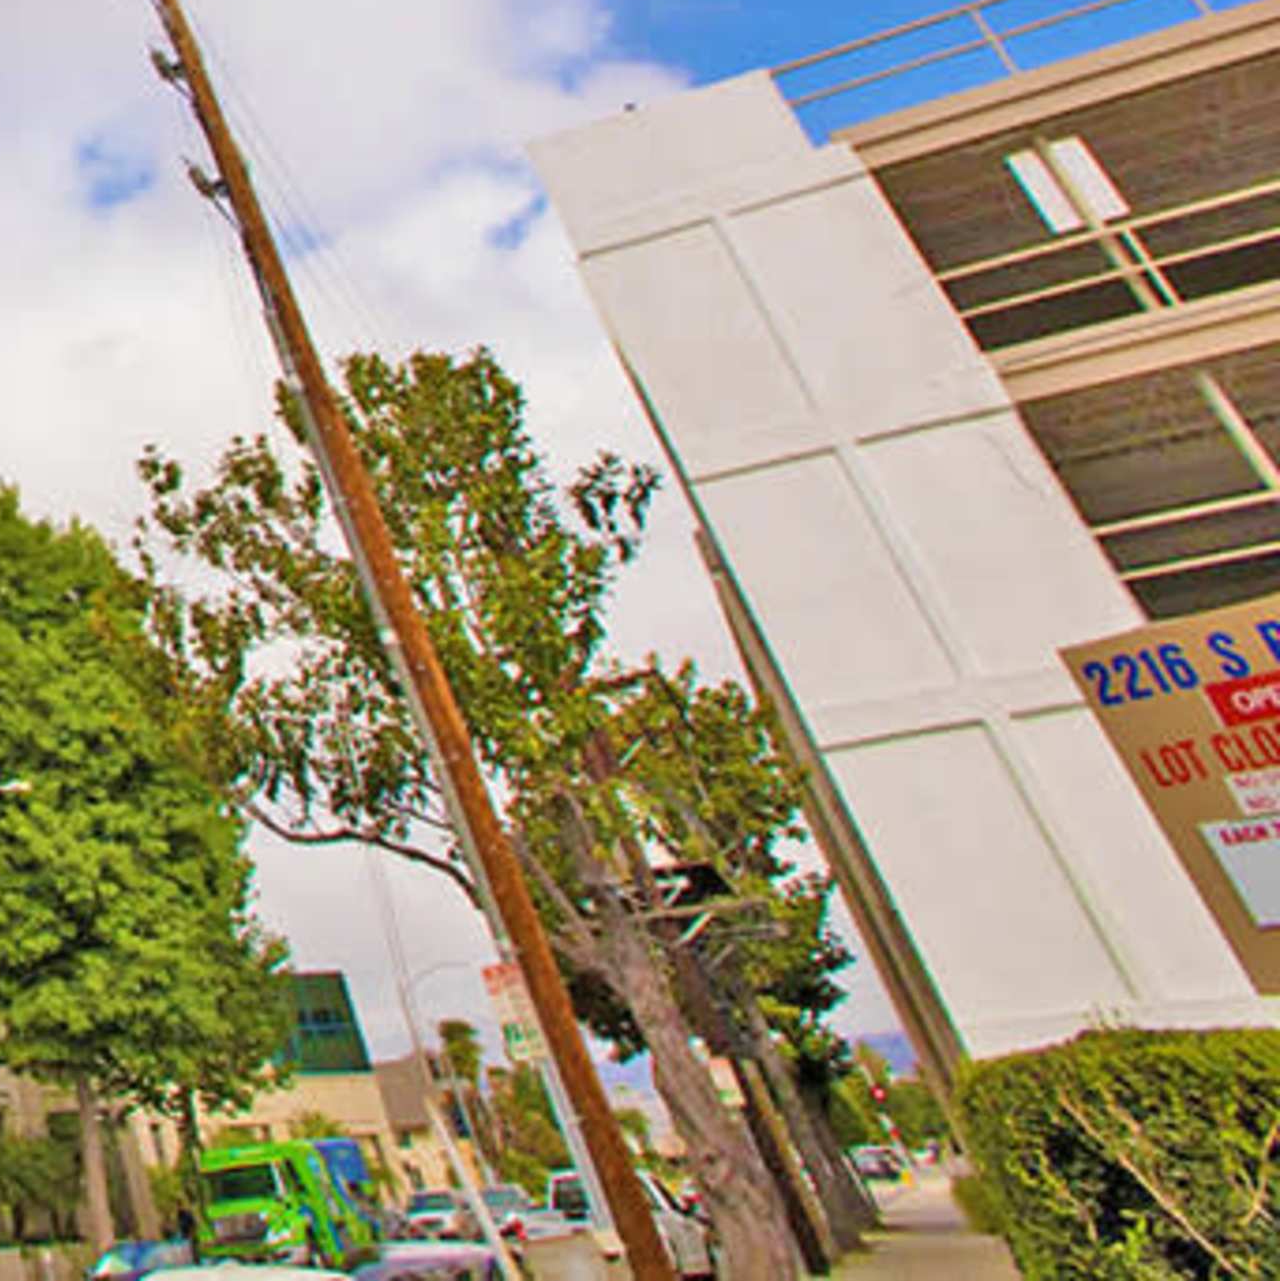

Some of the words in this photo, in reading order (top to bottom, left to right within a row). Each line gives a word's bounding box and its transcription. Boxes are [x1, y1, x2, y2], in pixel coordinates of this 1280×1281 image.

[1082, 643, 1199, 706] 2216
[1207, 631, 1251, 677] S
[1139, 738, 1208, 787] LOT
